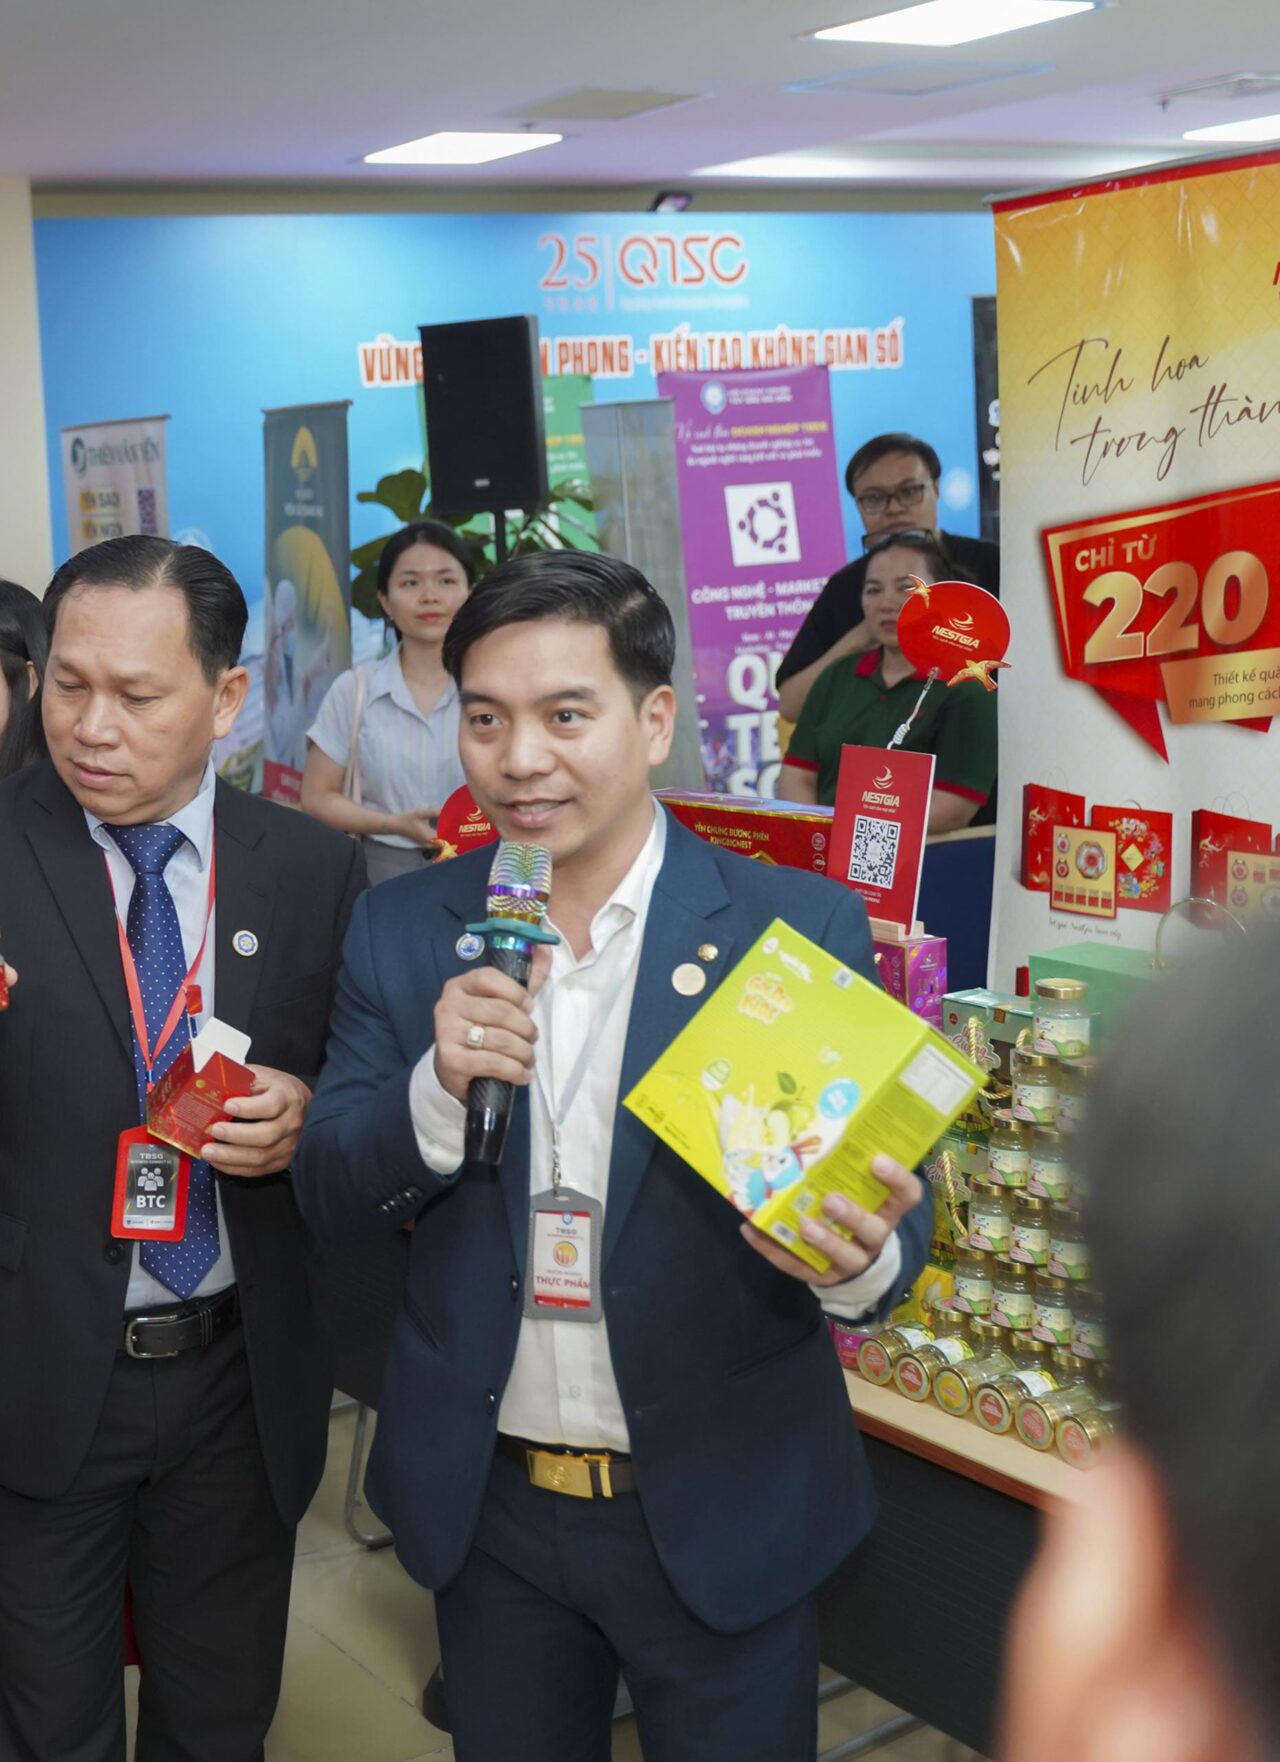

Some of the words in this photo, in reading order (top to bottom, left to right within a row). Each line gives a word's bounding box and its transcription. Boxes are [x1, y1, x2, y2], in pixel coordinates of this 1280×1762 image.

[539, 234, 599, 288] 25
[619, 235, 746, 285] QTSC
[558, 340, 630, 376] PHONG
[825, 334, 868, 365] GIAN
[1152, 335, 1210, 392] hoa
[1070, 415, 1186, 487] trong
[1074, 536, 1116, 572] CHỈ
[1122, 532, 1158, 564] TỪ
[1082, 550, 1269, 664] 220
[931, 624, 980, 649] NESTGIA
[1213, 670, 1239, 687] Thiết
[1242, 667, 1257, 683] kế
[1188, 696, 1215, 710] mang
[1218, 691, 1255, 709] phong
[862, 791, 901, 808] NESTGIA
[459, 822, 491, 833] NESTGIA
[136, 1195, 166, 1209] BTC
[535, 1275, 562, 1286] THỰC
